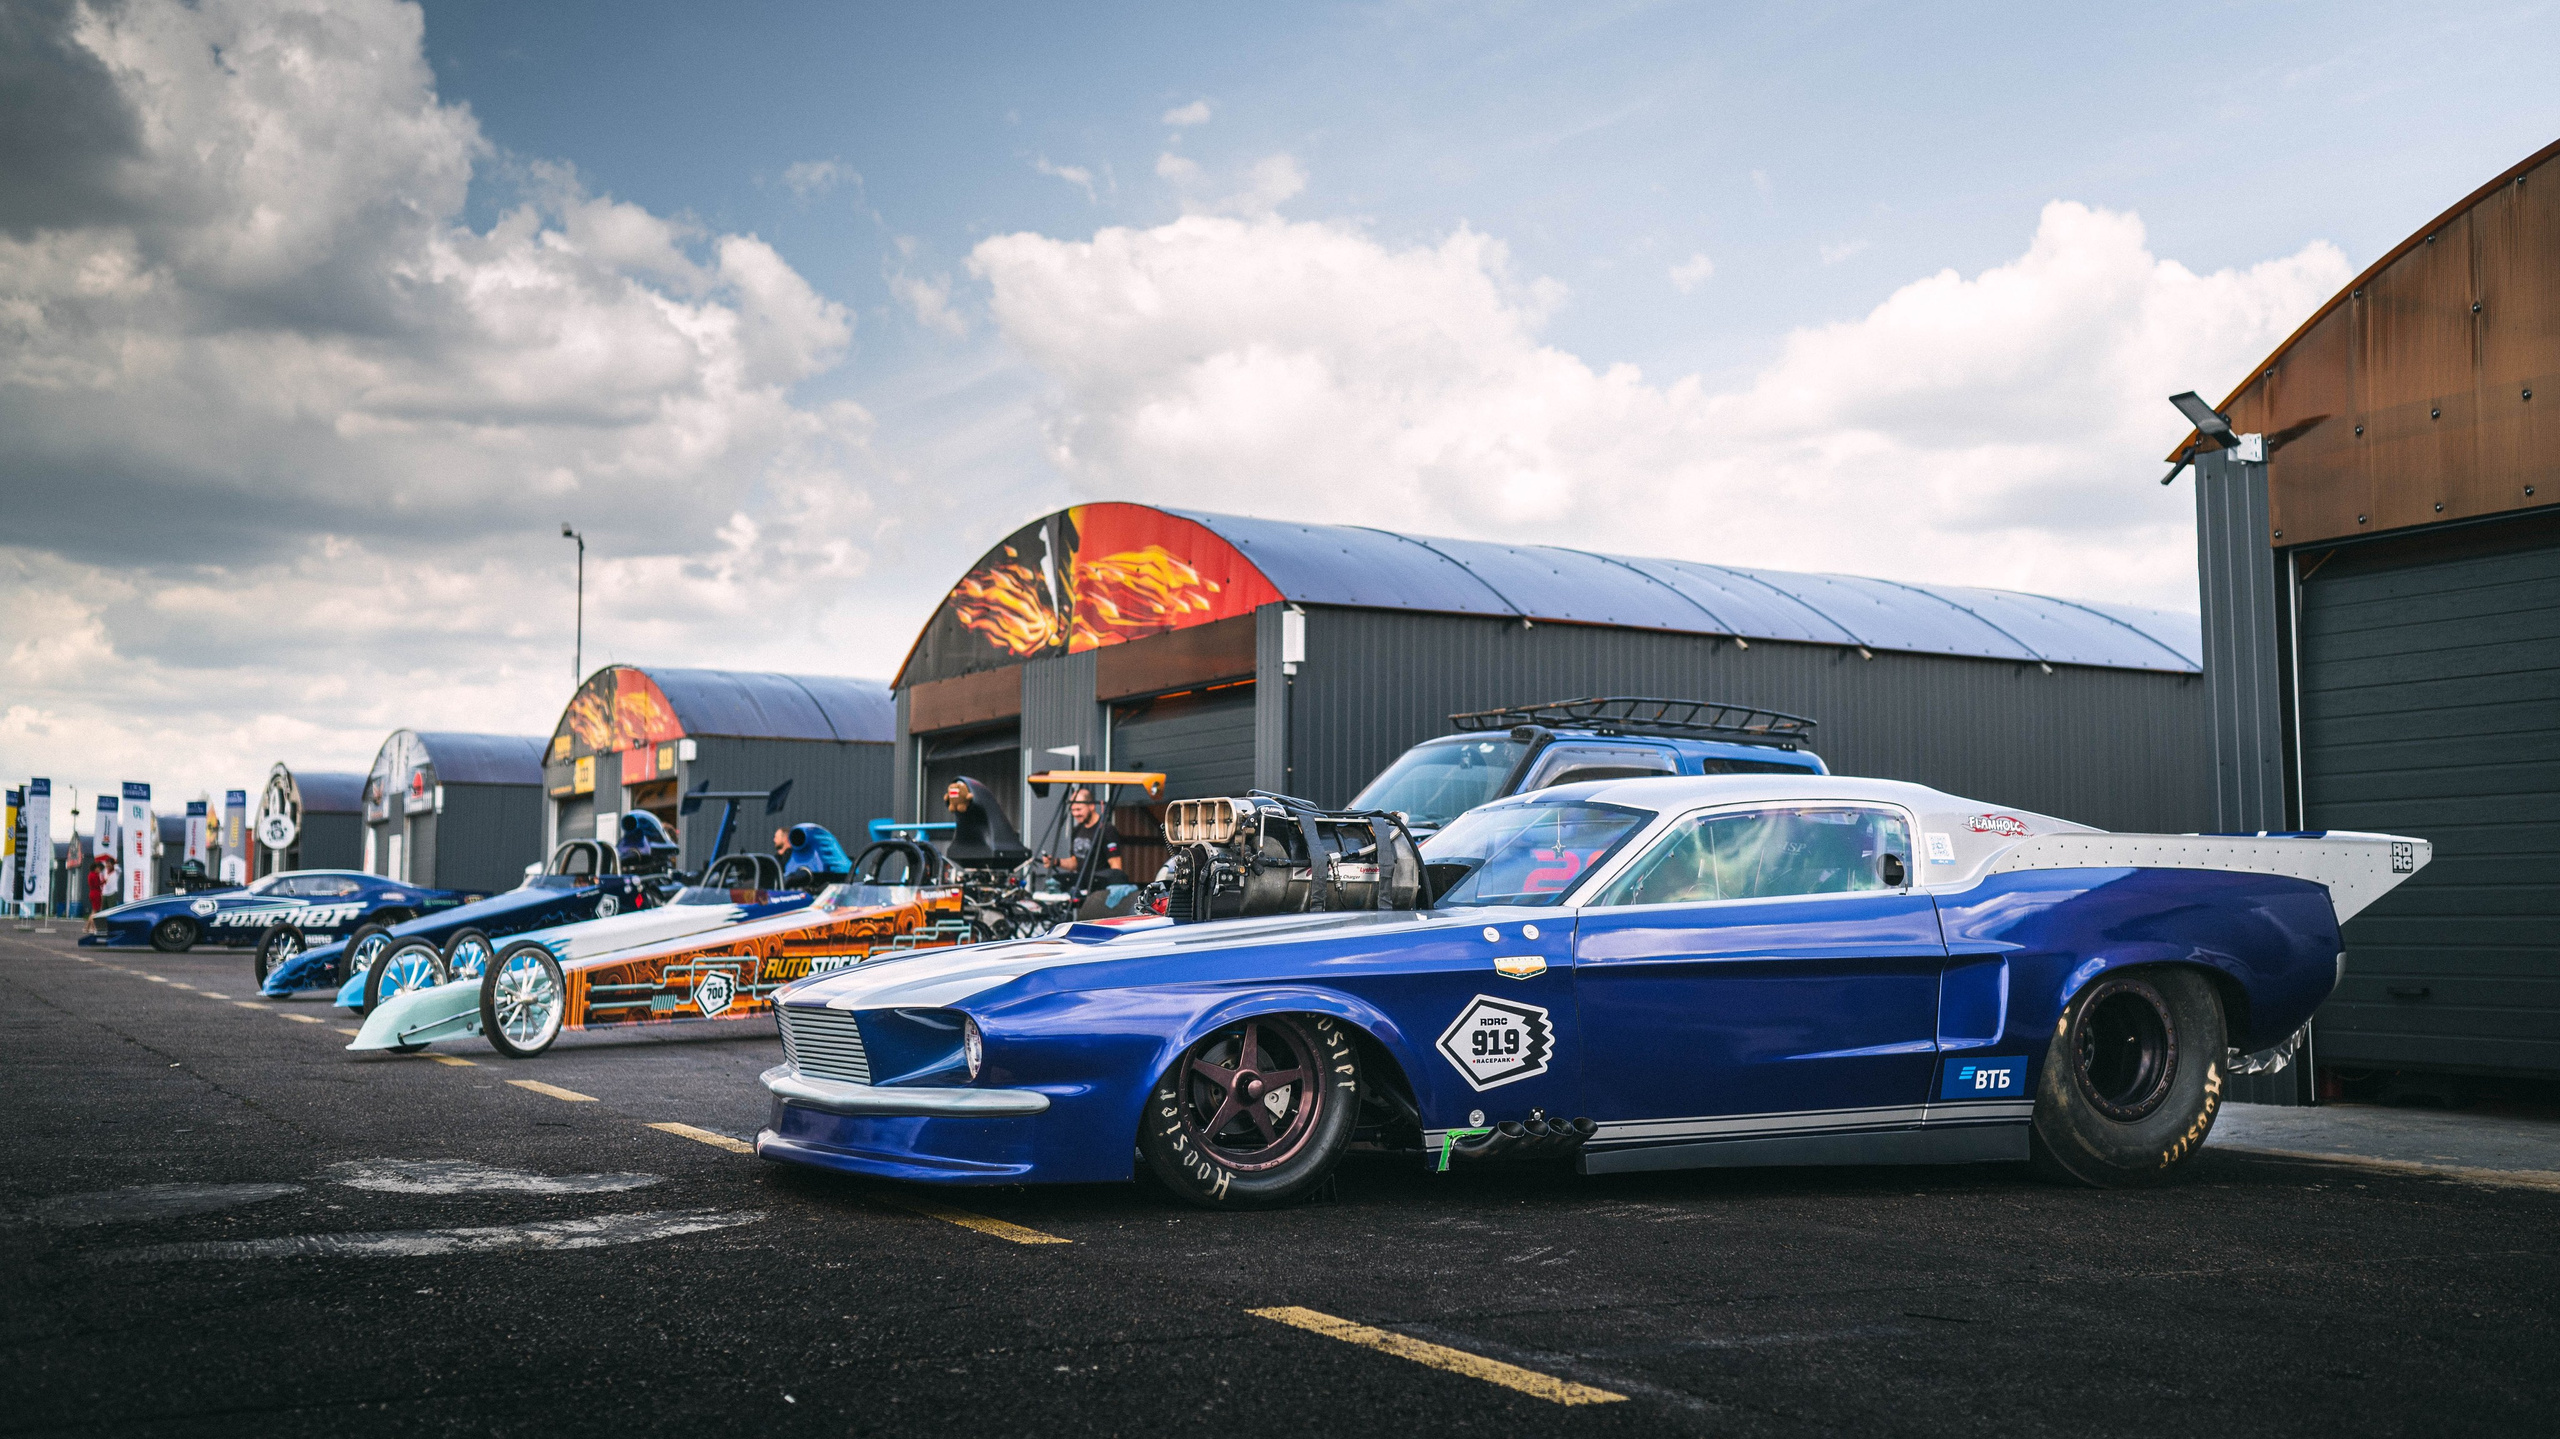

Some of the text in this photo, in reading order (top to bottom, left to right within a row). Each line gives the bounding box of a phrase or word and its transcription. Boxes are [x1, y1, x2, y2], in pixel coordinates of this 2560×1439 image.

[1968, 815, 2022, 832] FLAMHOLC
[2392, 843, 2412, 856] RD
[1359, 866, 1380, 874] Lyshol
[2392, 856, 2412, 870] RC
[707, 986, 723, 1000] 700
[1480, 1017, 1508, 1026] RDRC
[1472, 1028, 1520, 1056] 919
[1475, 1057, 1511, 1065] RACEPARK
[1975, 1069, 2011, 1090] ВТБ
[1157, 1089, 1237, 1201] Hoosier
